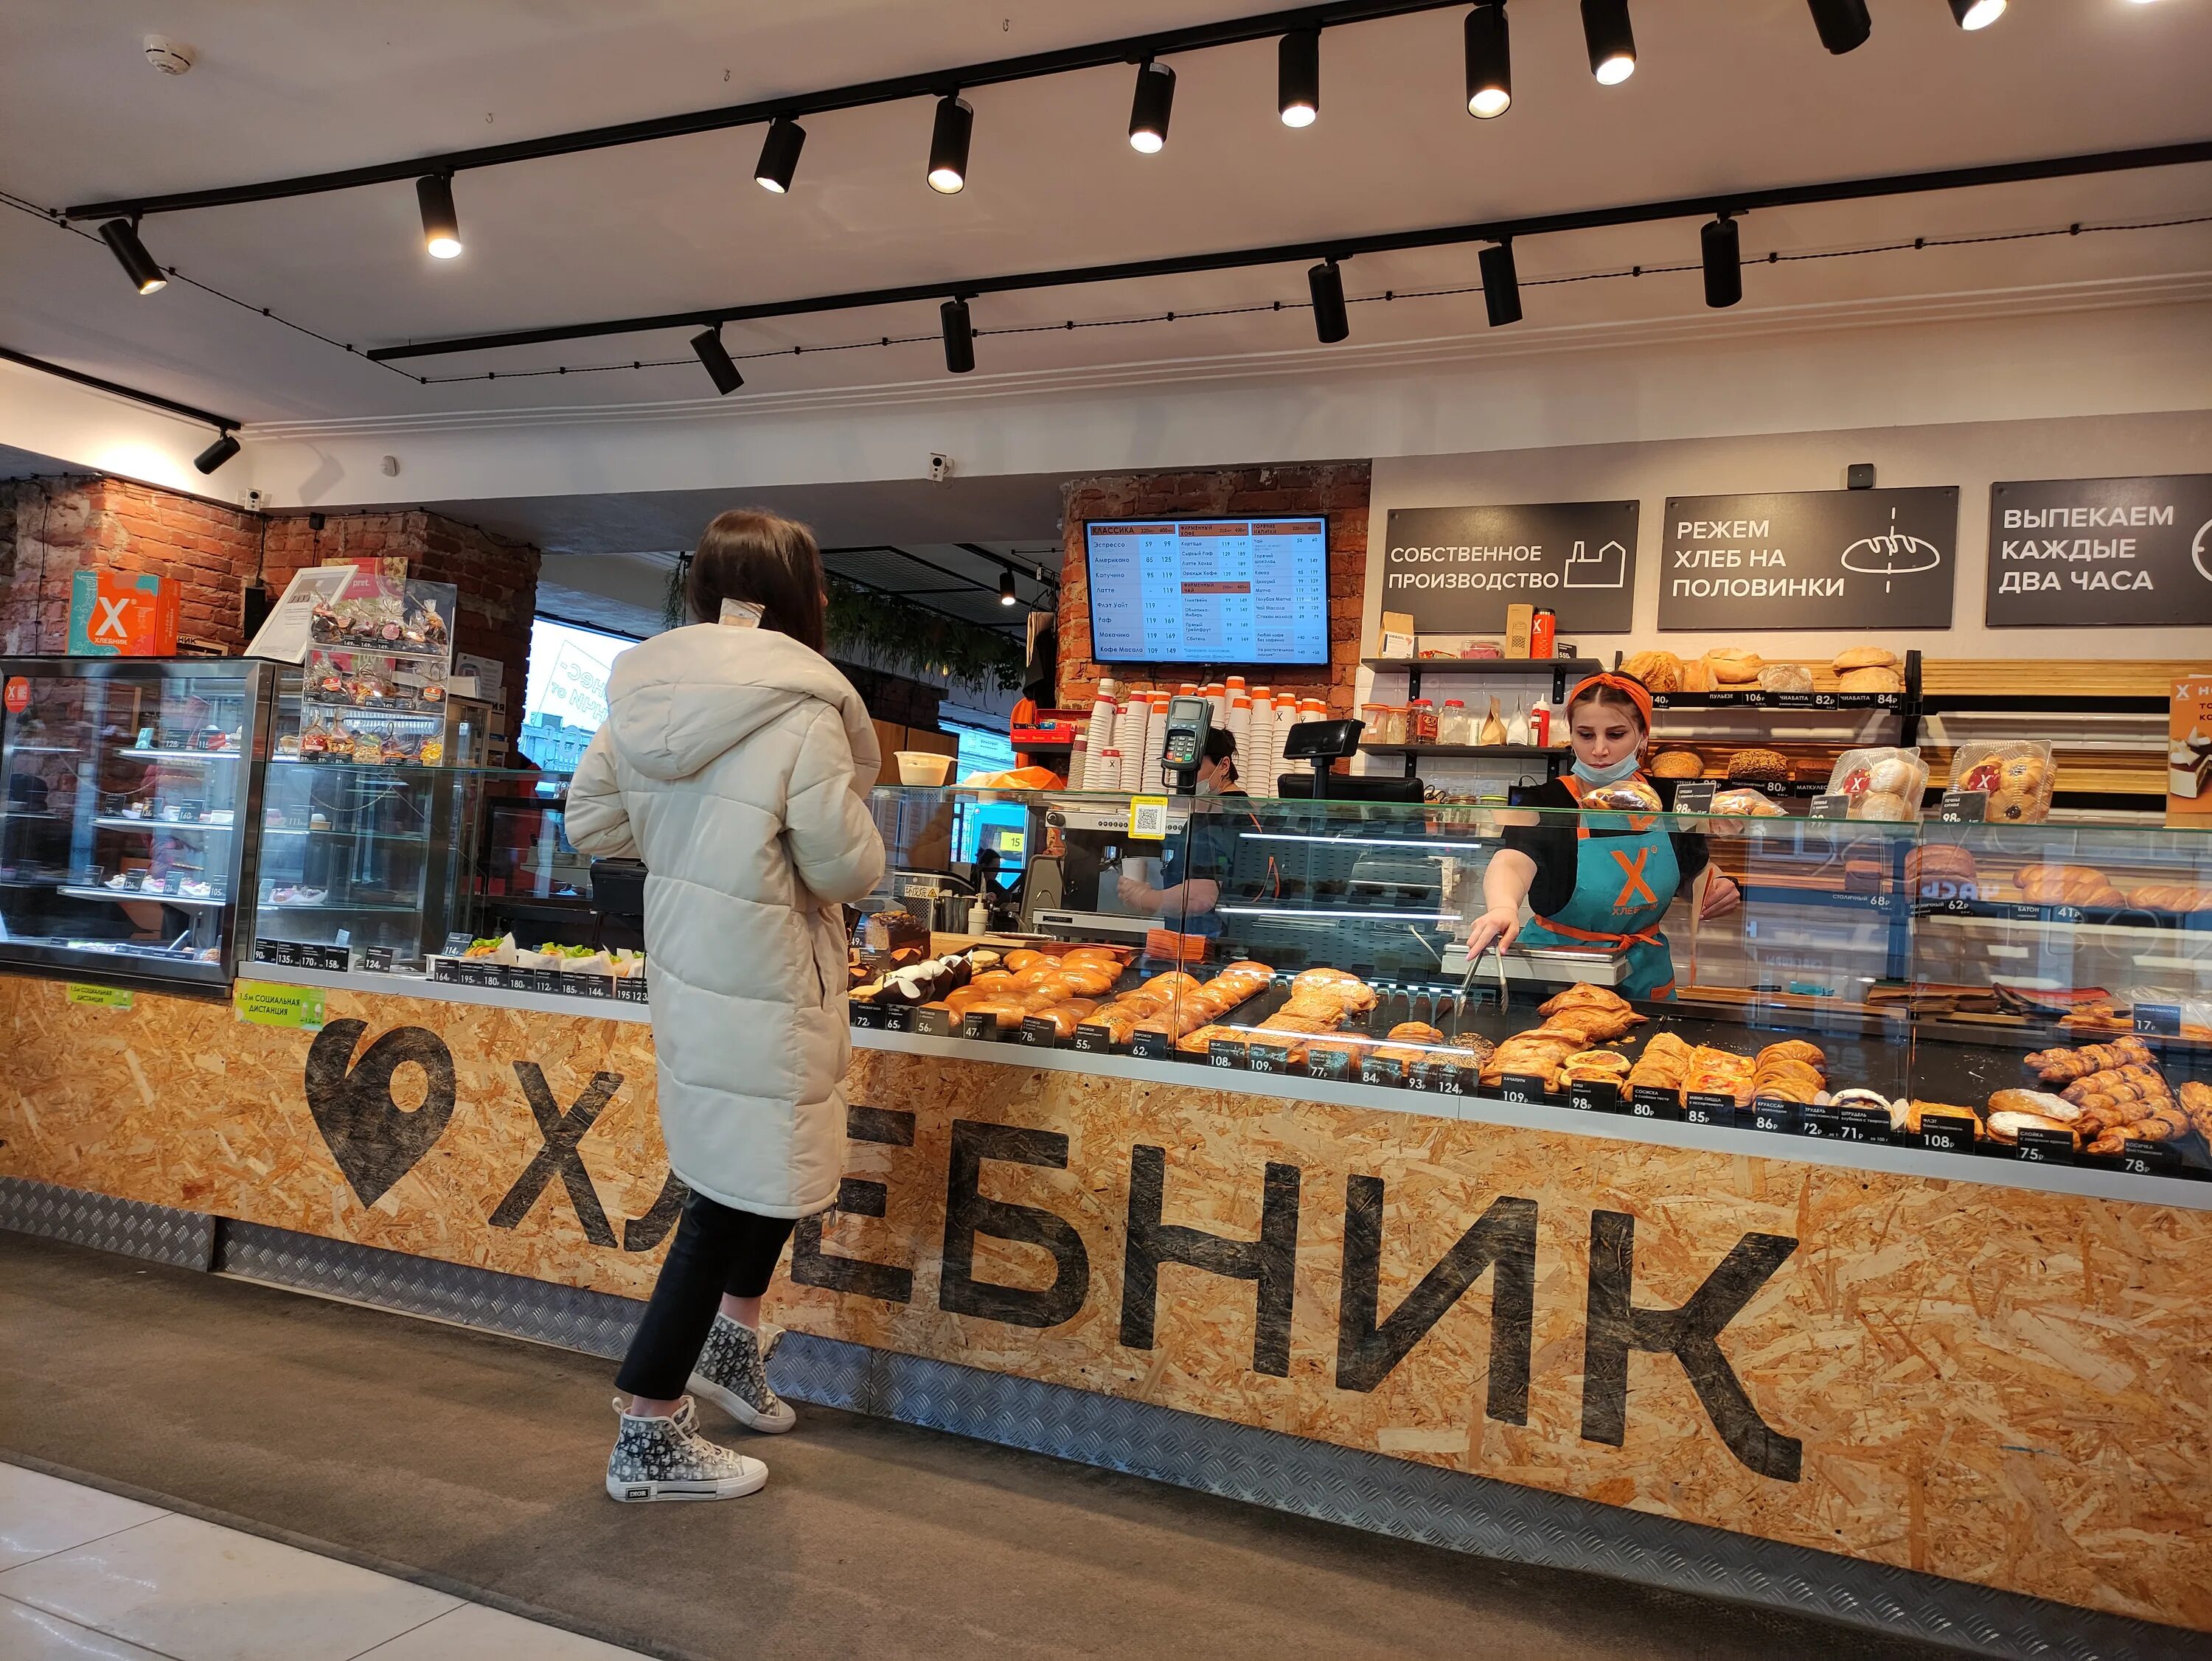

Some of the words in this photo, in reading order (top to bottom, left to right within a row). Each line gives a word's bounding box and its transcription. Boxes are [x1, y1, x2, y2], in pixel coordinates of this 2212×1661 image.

[2004, 506, 2174, 529] ВЫПЕКАЕМ
[1092, 526, 1135, 534] КЛАССИКА
[1677, 520, 1770, 539] РЕЖЕМ
[1390, 546, 1542, 563] СОБСТВЕННОЕ
[2002, 538, 2136, 563] КАЖДЫЕ
[1674, 549, 1742, 568] ХЛЕБ
[1749, 549, 1787, 568] НА
[1388, 572, 1559, 591] ПРОИЗВОДСТВО
[1999, 571, 2062, 593] ДВА
[2070, 570, 2154, 591] ЧАСА
[1672, 577, 1846, 598] ПОЛОВИНКИ
[94, 637, 128, 645] ХЛЕБНИК
[1745, 693, 1765, 702] 106₽
[1815, 695, 1835, 705] 82₽
[1877, 694, 1897, 704] 84₽
[1767, 782, 1787, 792] 80₽
[1011, 838, 1020, 847] 15
[1610, 848, 1658, 907] Х
[1832, 894, 1868, 902] СТОЛИЧНЫЙ
[1870, 896, 1891, 907] 68₽
[1948, 900, 1969, 910] 62₽
[255, 995, 301, 1006] СОЦИАЛЬНАЯ
[248, 1005, 288, 1016] ДИСТАНЦИЯ
[857, 1017, 870, 1026] 72₽
[887, 1020, 901, 1029] 65₽
[2136, 1020, 2156, 1031] 17₽
[965, 1027, 980, 1037] 47₽
[1021, 1031, 1036, 1042] 78₽
[1076, 1039, 1091, 1050] 55₽
[1133, 1045, 1149, 1056] 62₽
[1210, 1056, 1232, 1067] 108₽
[1251, 1059, 1273, 1071] 109₽
[1310, 1066, 1327, 1077] 77₽
[1362, 1071, 1380, 1084] 84₽
[1409, 1077, 1426, 1090] 93₽
[1439, 1082, 1464, 1094] 124₽
[1503, 1090, 1528, 1103] 109₽
[1688, 1095, 1722, 1103] МИНИ-ПИЦЦА
[1572, 1098, 1592, 1110] 98₽
[1633, 1104, 1655, 1116] 80₽
[1688, 1110, 1709, 1123] 85₽
[1756, 1117, 1778, 1130] 86₽
[1841, 1127, 1863, 1140] 71₽
[1923, 1134, 1955, 1149] 108₽
[2020, 1147, 2045, 1160] 75₽
[2124, 1158, 2150, 1172] 78₽
